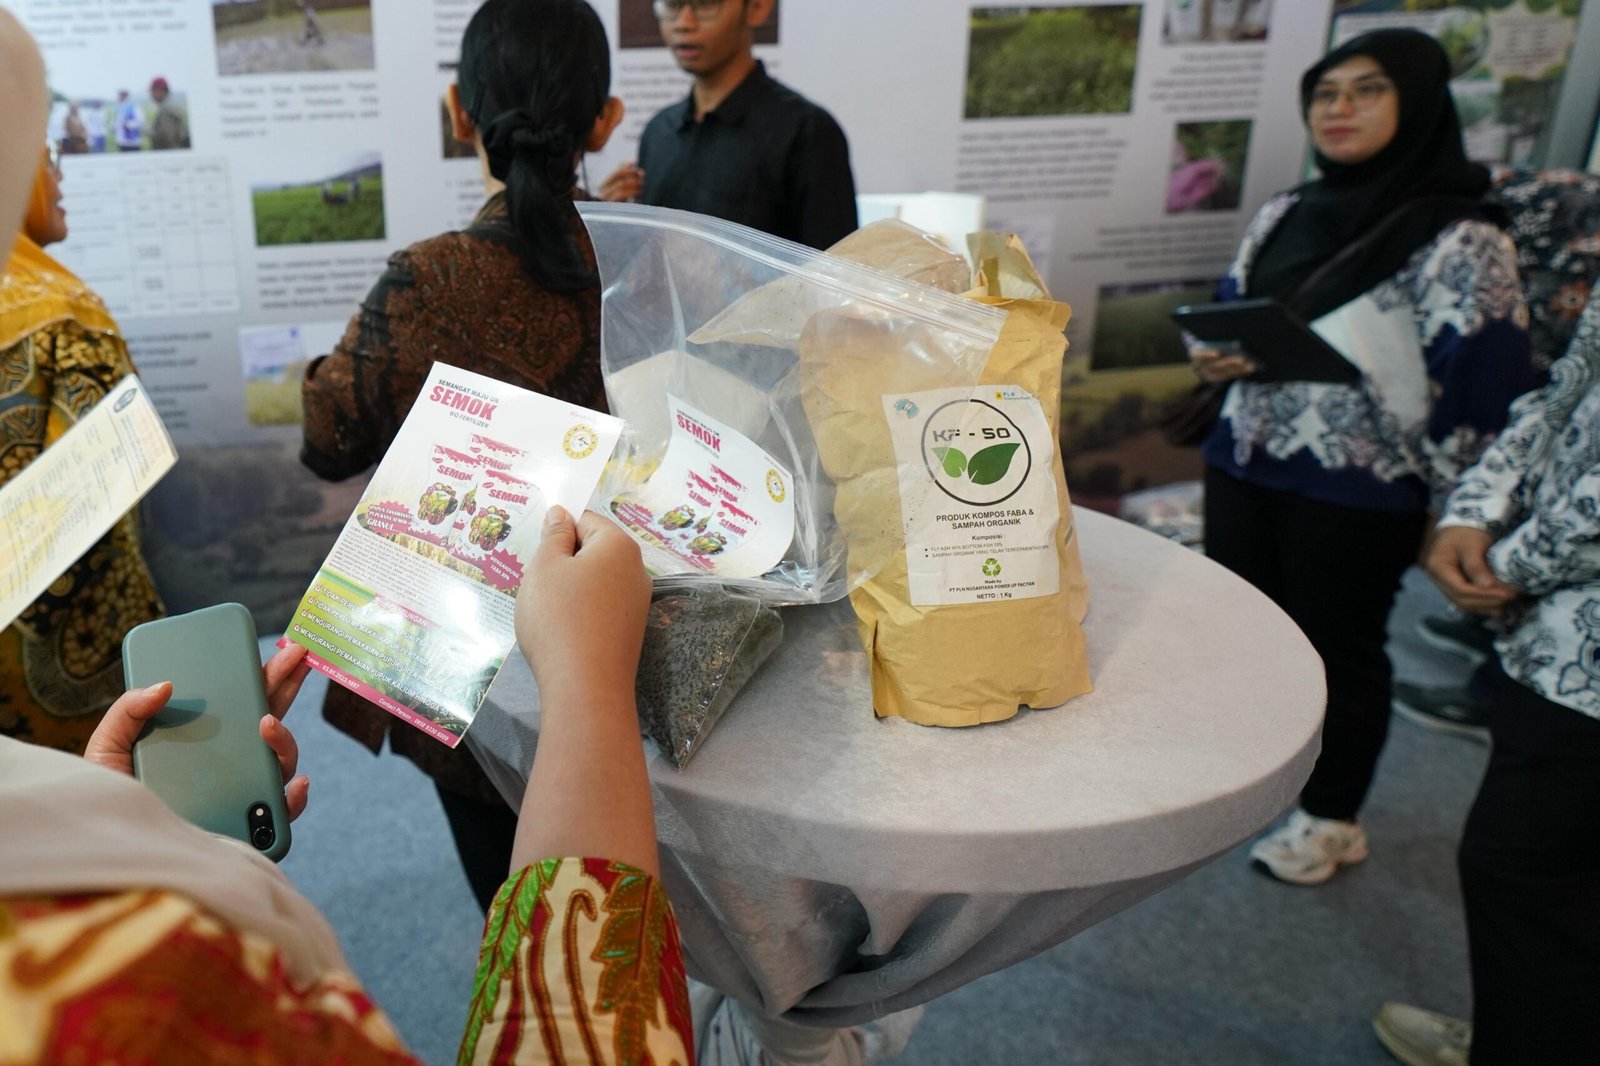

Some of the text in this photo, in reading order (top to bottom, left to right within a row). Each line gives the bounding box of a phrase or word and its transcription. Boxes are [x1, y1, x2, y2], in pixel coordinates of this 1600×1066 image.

[440, 379, 471, 394] SEMANGAT
[471, 389, 489, 400] MAJU
[430, 385, 497, 421] SEMOK
[459, 414, 489, 428] FERTILIZER
[677, 414, 720, 452] SEMOK
[437, 464, 474, 481] SEMOK
[477, 454, 513, 471] SEMOK
[488, 488, 529, 505] SEMOK
[688, 490, 712, 508] SEMOK
[715, 484, 738, 502] SEMOK
[936, 508, 1034, 522] PRODUK KOMPOS FABA &
[952, 518, 1021, 530] SAMPAH ORGANIK
[719, 518, 747, 537] SEMOK
[490, 555, 521, 578] MENGANDUNG
[322, 588, 360, 612] TIDAK PERLU
[315, 601, 331, 615] TIDAK
[330, 610, 350, 624] PERLU
[352, 618, 378, 638] MEMAKAI
[378, 636, 400, 650] KAPUR
[308, 613, 345, 637] MENGURANGI
[344, 634, 381, 657] PEMAKAIAN
[380, 654, 400, 670] PUPUK
[400, 665, 418, 680] UREA
[300, 628, 336, 652] MENGURANGI
[336, 648, 370, 672] PEMAKAIAN
[370, 667, 392, 684] PUPUK
[392, 680, 416, 700] KALIUM
[415, 693, 440, 711] HINGGA
[379, 698, 395, 712] Contact
[395, 707, 412, 720] Person
